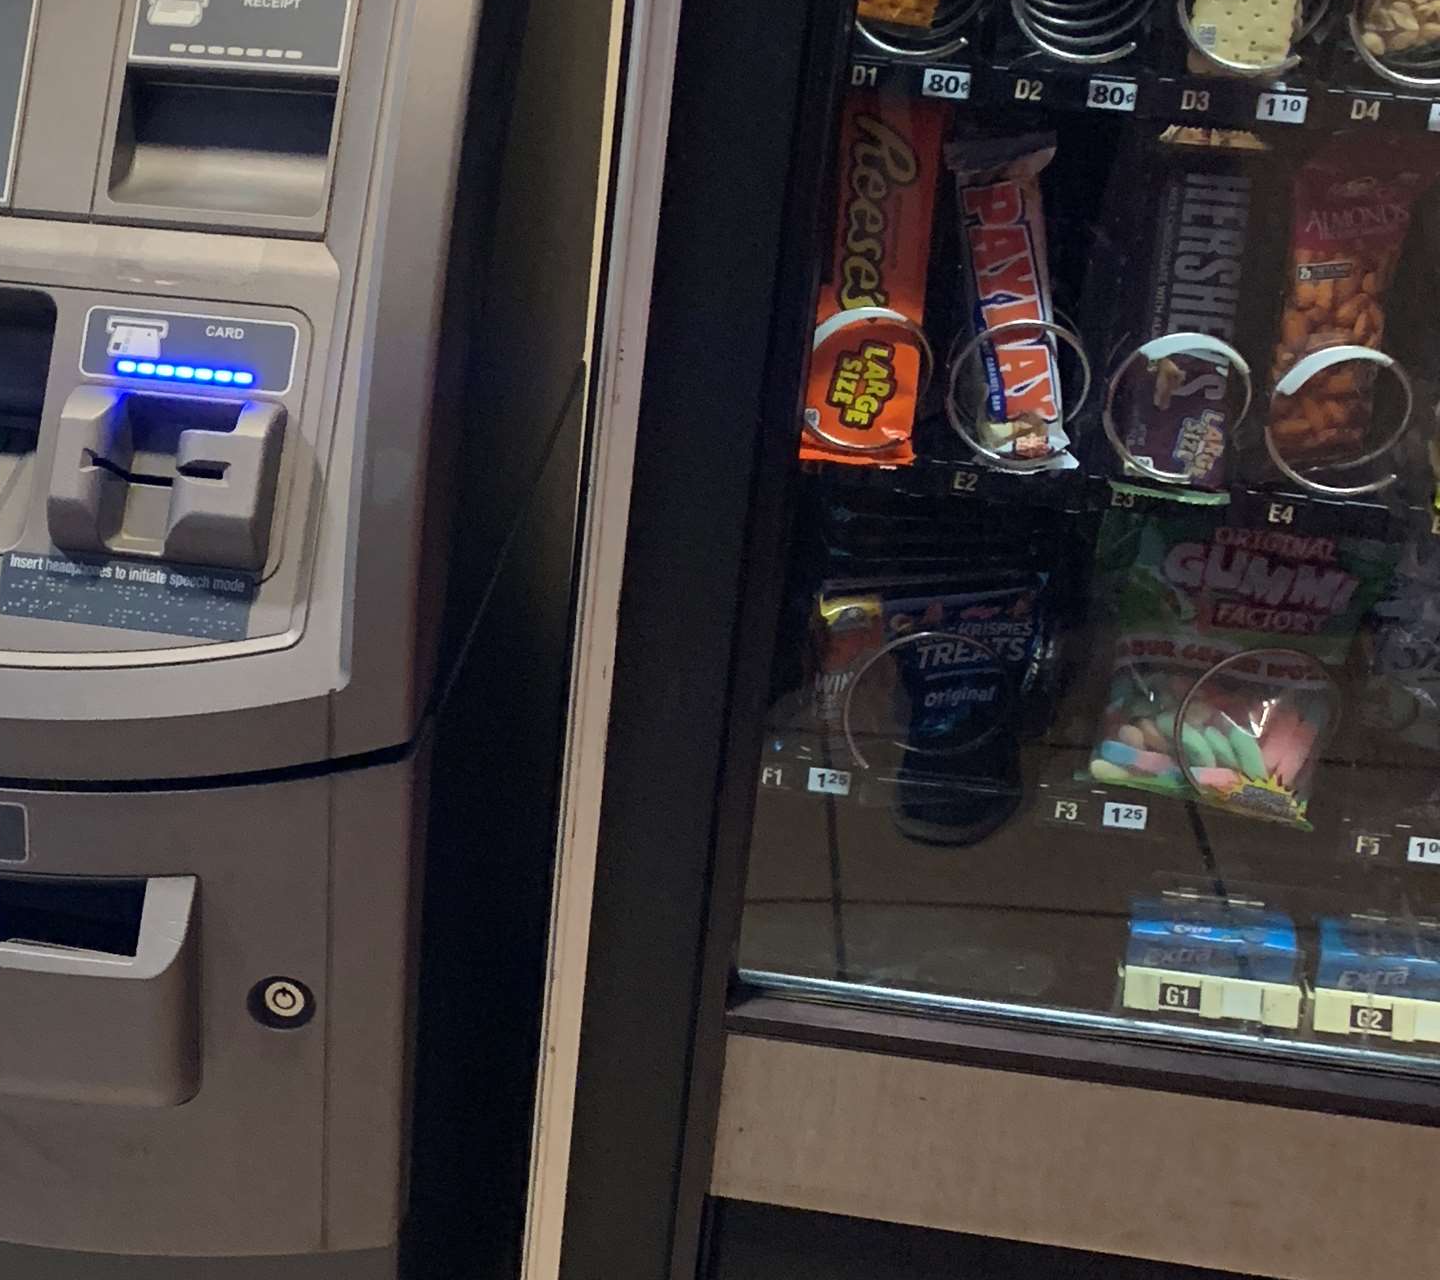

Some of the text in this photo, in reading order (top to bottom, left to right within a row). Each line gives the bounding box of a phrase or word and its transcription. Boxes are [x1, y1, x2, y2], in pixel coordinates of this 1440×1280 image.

[851, 65, 877, 87] D1
[927, 73, 970, 94] 80¢
[1014, 78, 1044, 100] D2
[1091, 85, 1135, 106] 80¢
[1180, 90, 1210, 111] D3
[1350, 99, 1381, 121] D4
[962, 180, 1058, 422] PAYDAY
[205, 324, 245, 341] CARD
[832, 357, 863, 405] SIZE
[845, 346, 891, 426] LARGE
[1189, 412, 1225, 480] LARGE
[953, 472, 976, 491] E2
[1268, 503, 1294, 524] E4
[1215, 526, 1338, 562] ORIGINAL
[9, 553, 43, 570] Insert
[115, 566, 127, 579] to
[129, 566, 167, 584] initiate
[169, 573, 210, 589] speech
[212, 577, 245, 593] mode
[958, 621, 1033, 637] KRISPIES
[1210, 603, 1332, 634] FACTORY
[762, 766, 782, 786] F1
[1055, 801, 1078, 821] F3
[1355, 834, 1380, 855] F5
[1165, 986, 1190, 1006] G1
[1356, 1009, 1384, 1030] G2
